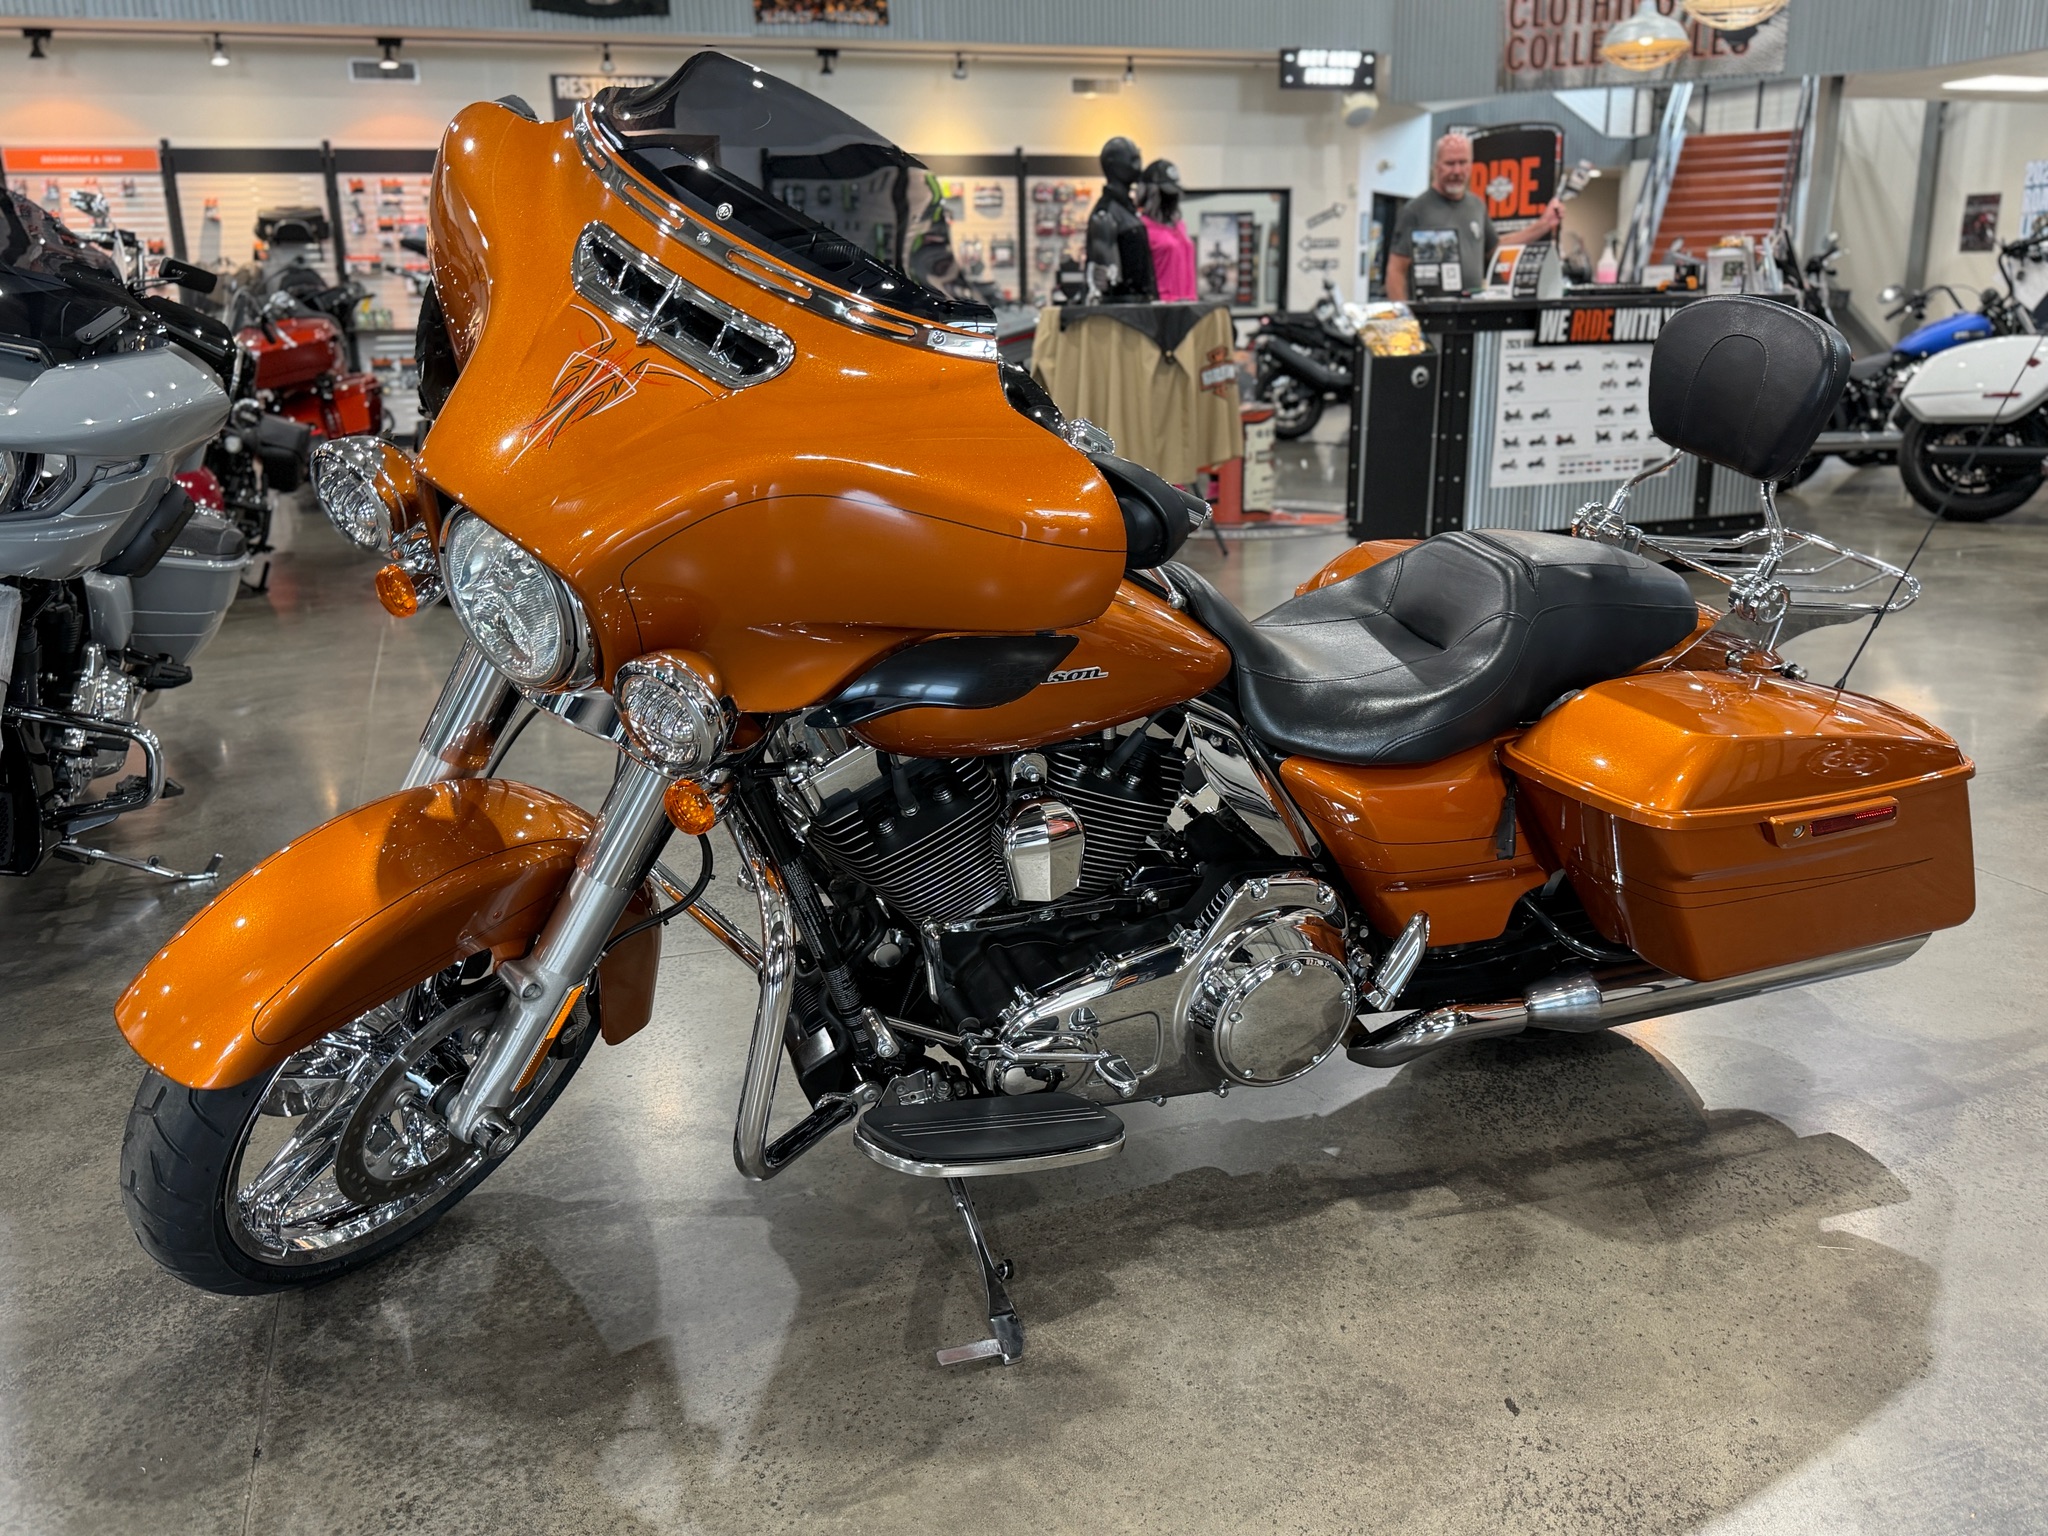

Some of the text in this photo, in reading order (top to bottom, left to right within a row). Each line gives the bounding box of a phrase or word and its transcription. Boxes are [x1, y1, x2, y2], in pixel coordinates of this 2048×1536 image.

[1510, 0, 1675, 29] CLOTHI
[1507, 31, 1748, 70] COLLELE
[555, 75, 656, 99] RESTR
[1538, 308, 1571, 343] WE
[1570, 308, 1614, 342] RIDE
[1613, 307, 1662, 341] WITH
